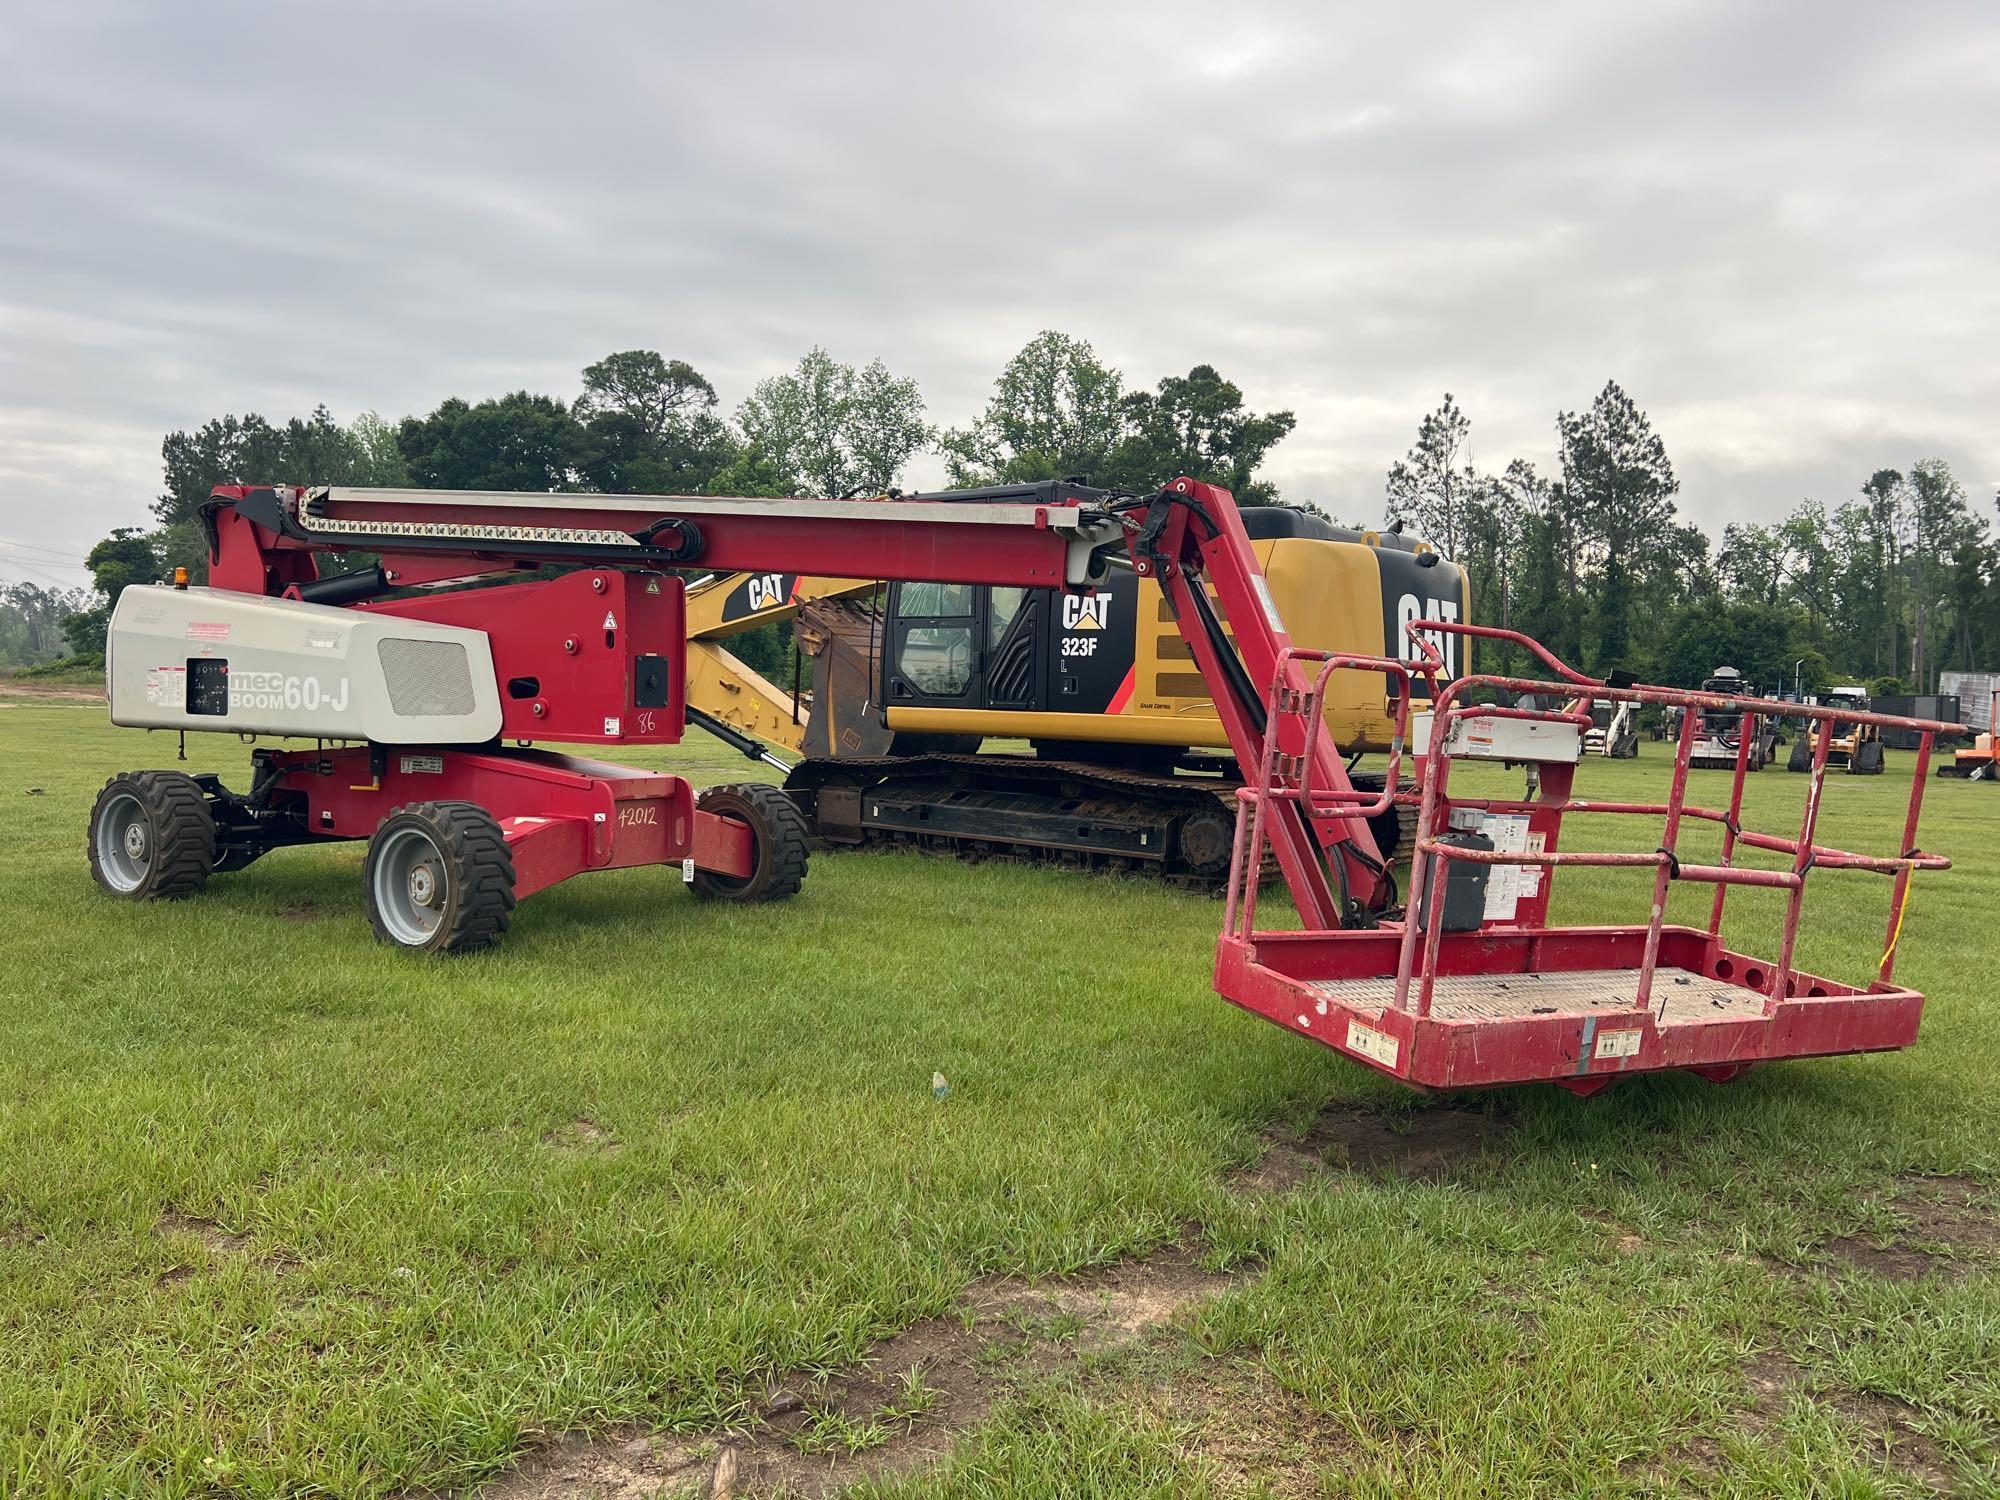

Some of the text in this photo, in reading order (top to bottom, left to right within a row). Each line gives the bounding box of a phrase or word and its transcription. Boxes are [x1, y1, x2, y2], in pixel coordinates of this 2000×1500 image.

[748, 574, 783, 611] CAT
[1062, 593, 1112, 630] CAT
[1061, 637, 1098, 657] 323F
[1398, 593, 1457, 681] CAT
[229, 674, 283, 691] mec
[229, 676, 349, 711] BOOM 60-J
[637, 711, 656, 734] 86
[617, 806, 658, 829] 42012
